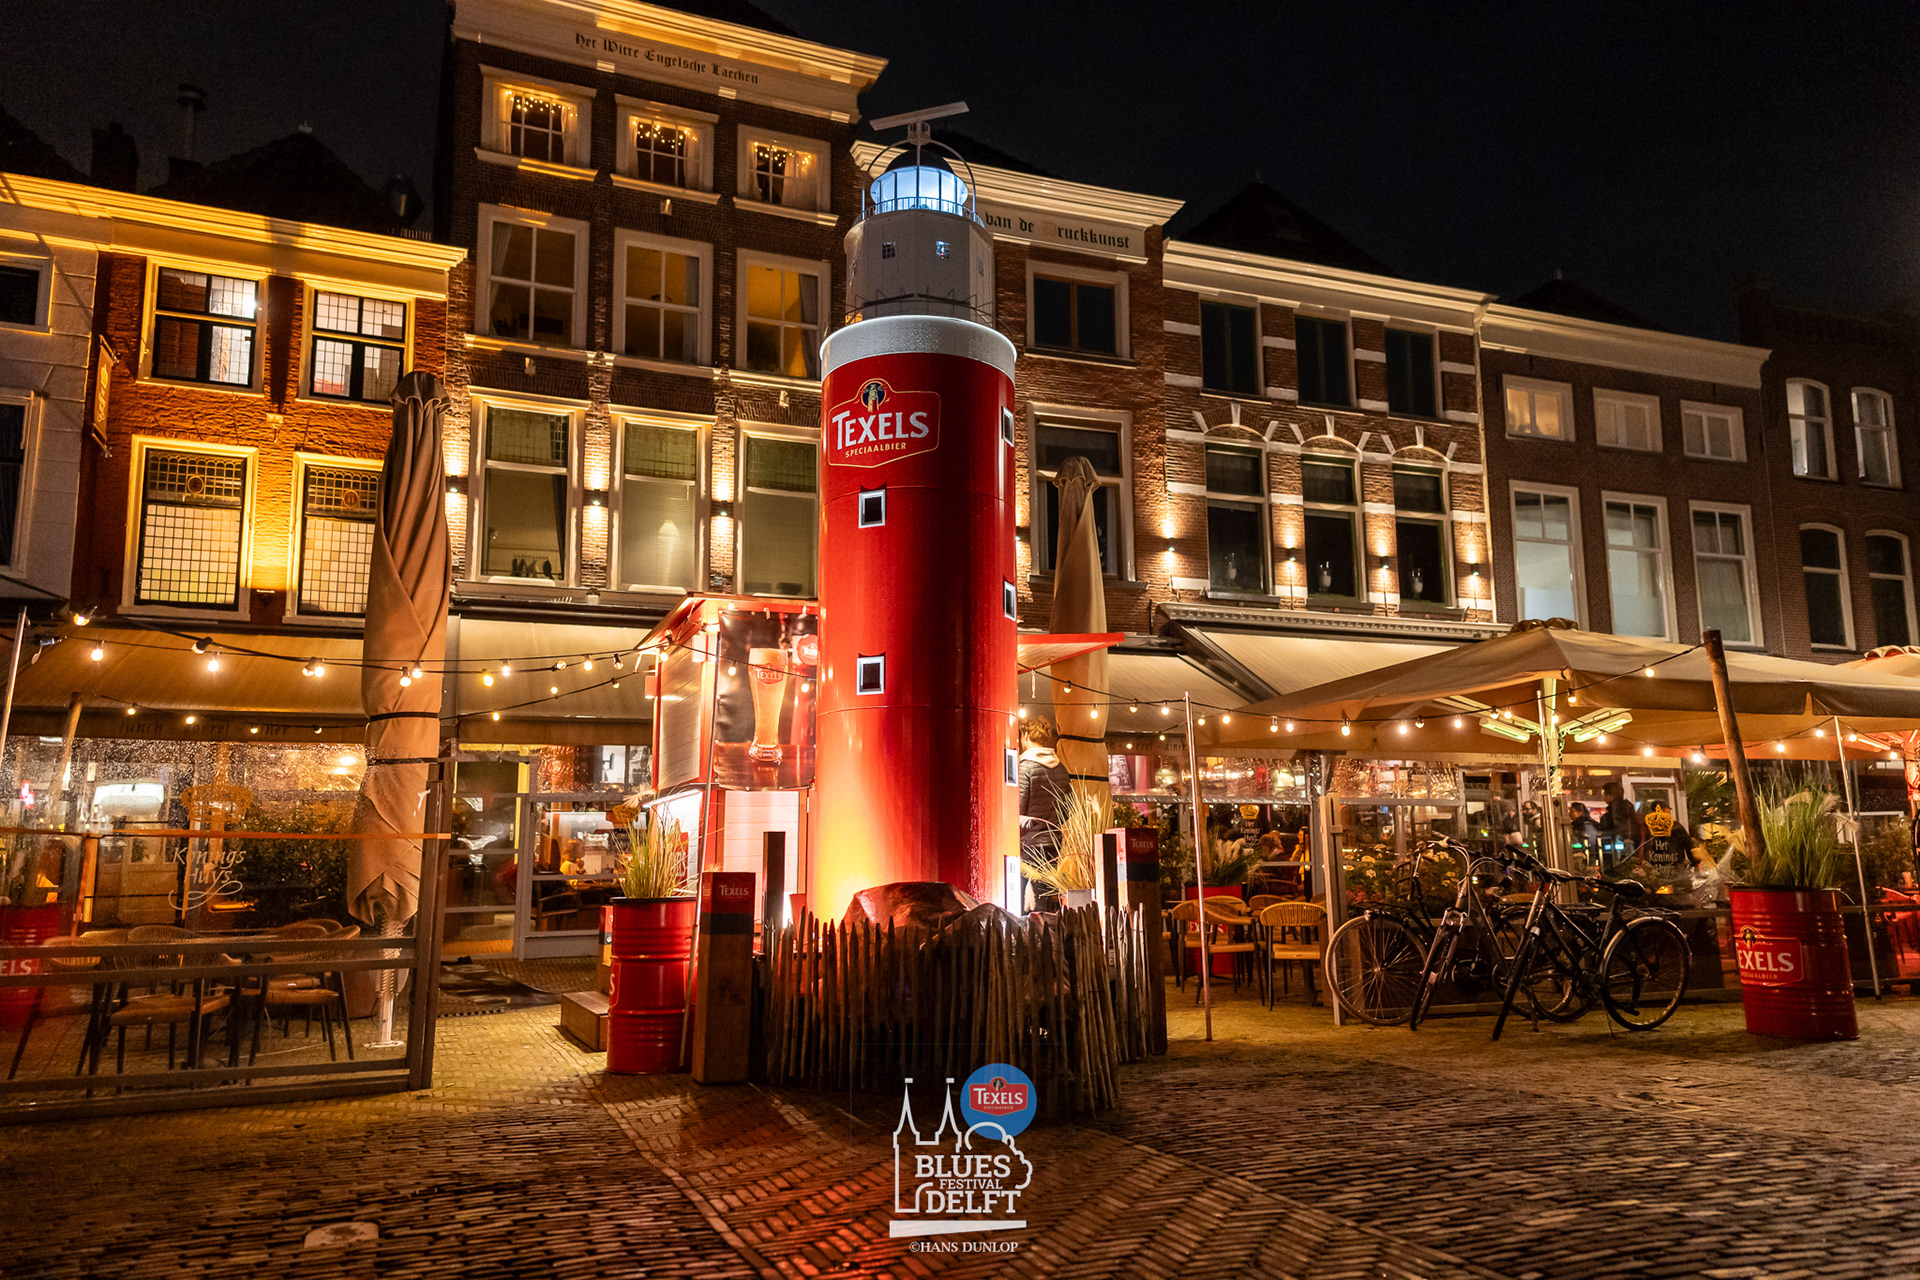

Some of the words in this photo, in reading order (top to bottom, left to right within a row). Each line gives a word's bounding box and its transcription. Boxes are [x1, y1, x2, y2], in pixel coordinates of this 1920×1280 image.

[575, 32, 597, 49] Het
[603, 38, 639, 58] Witte
[644, 50, 707, 75] Engelsche
[712, 62, 759, 84] Laecken
[985, 211, 1012, 229] van
[1019, 217, 1035, 233] de
[831, 410, 930, 451] TEXELS
[845, 441, 907, 459] SPECIAALBIER
[755, 668, 783, 680] TEXELS
[119, 720, 164, 736] lunch
[250, 723, 290, 736] iner
[1130, 838, 1154, 849] TEXELS
[1655, 840, 1669, 851] Het
[1648, 850, 1679, 866] Konings
[719, 884, 750, 897] TEXELS
